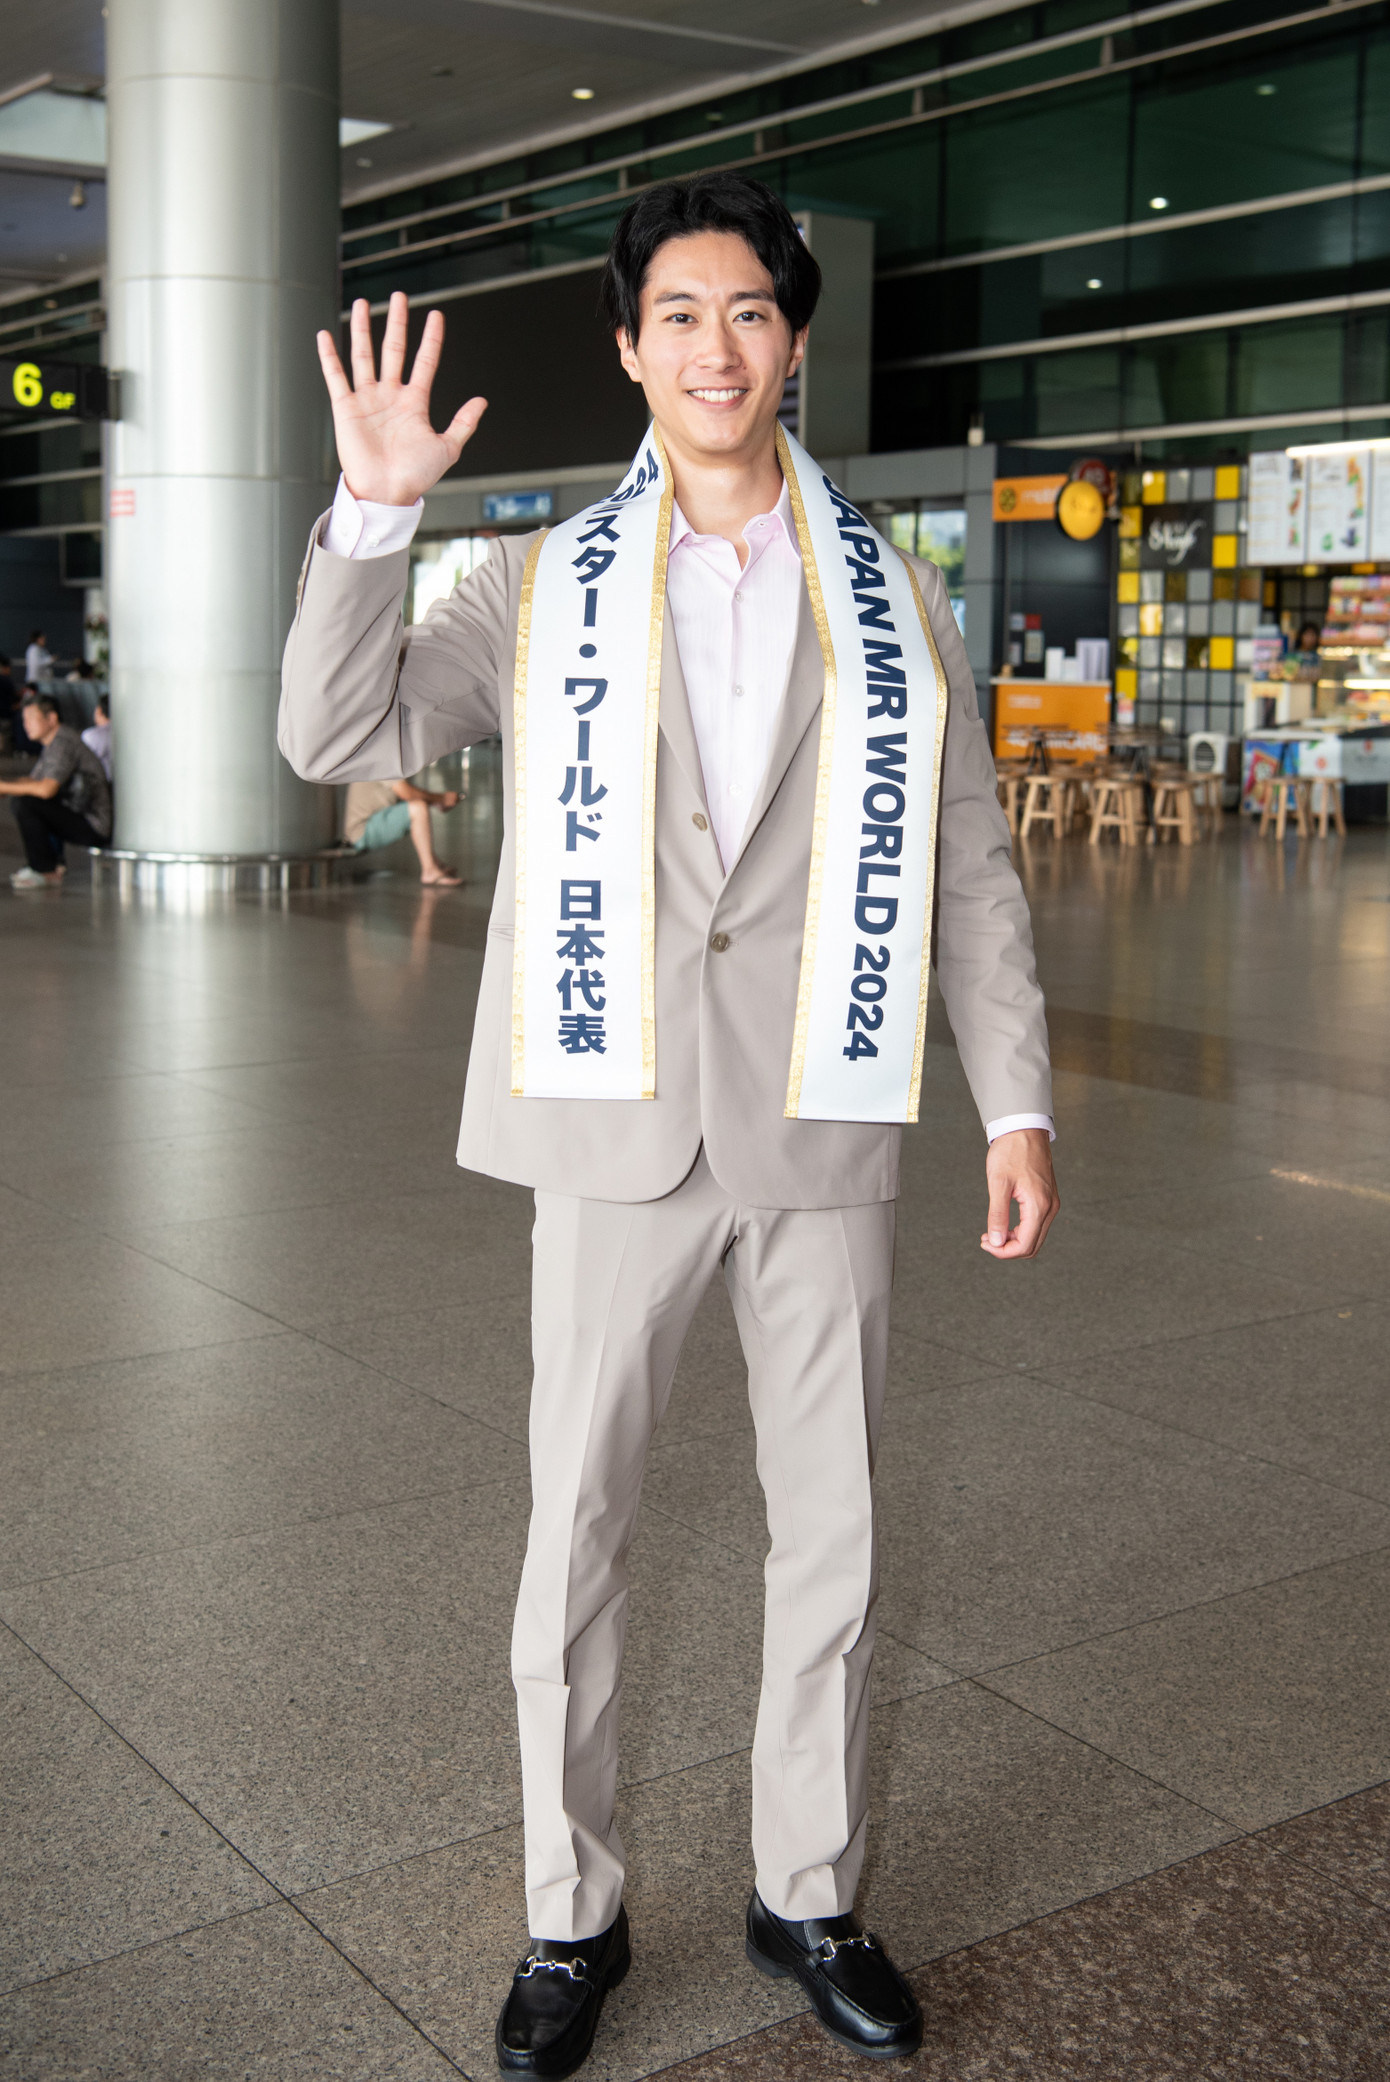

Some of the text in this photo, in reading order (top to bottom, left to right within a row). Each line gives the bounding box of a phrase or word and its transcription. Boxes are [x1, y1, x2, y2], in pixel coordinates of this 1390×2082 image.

[13, 362, 43, 407] 6
[822, 475, 908, 1062] JAPAN MR WORLD 2024
[556, 879, 607, 1055] 日本代表
